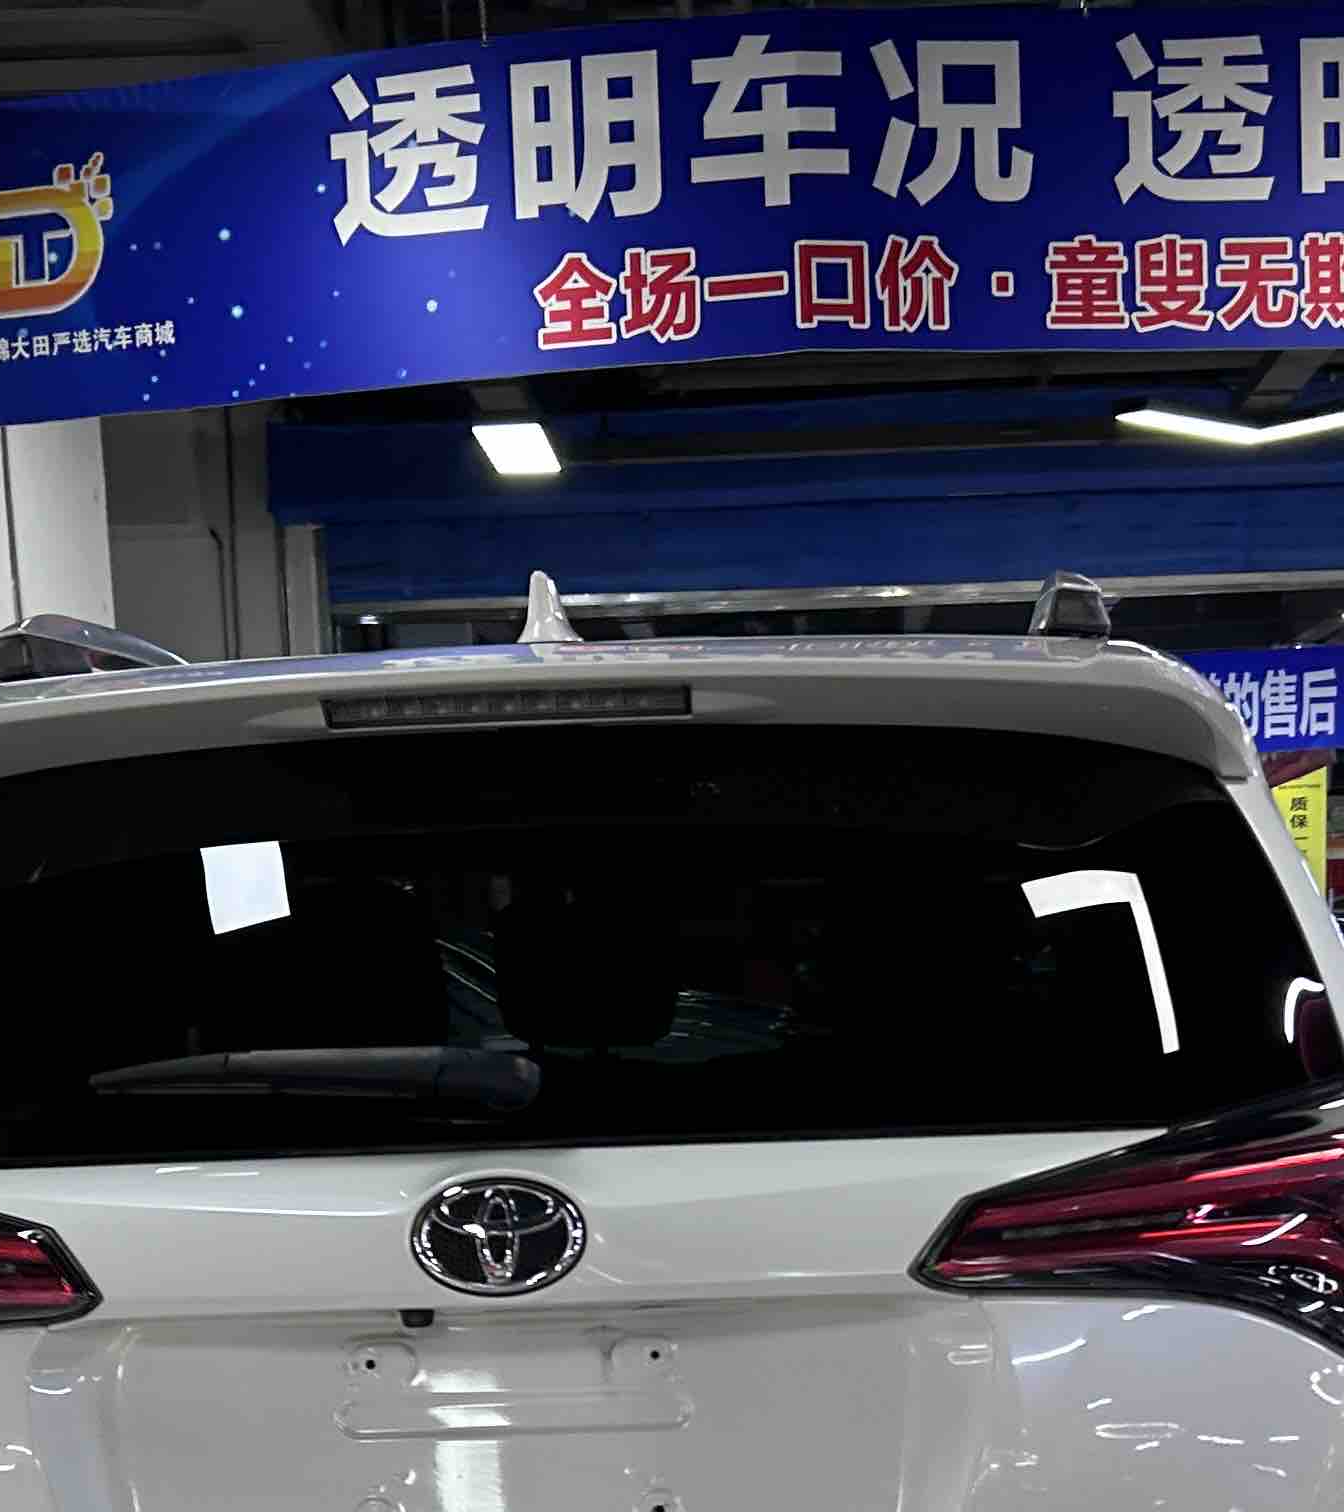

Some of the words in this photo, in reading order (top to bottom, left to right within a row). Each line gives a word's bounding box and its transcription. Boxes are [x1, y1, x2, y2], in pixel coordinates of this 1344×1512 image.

[328, 34, 1034, 247] 透明车况
[1209, 668, 1338, 739] 的售后
[1289, 796, 1309, 856] 质保一
